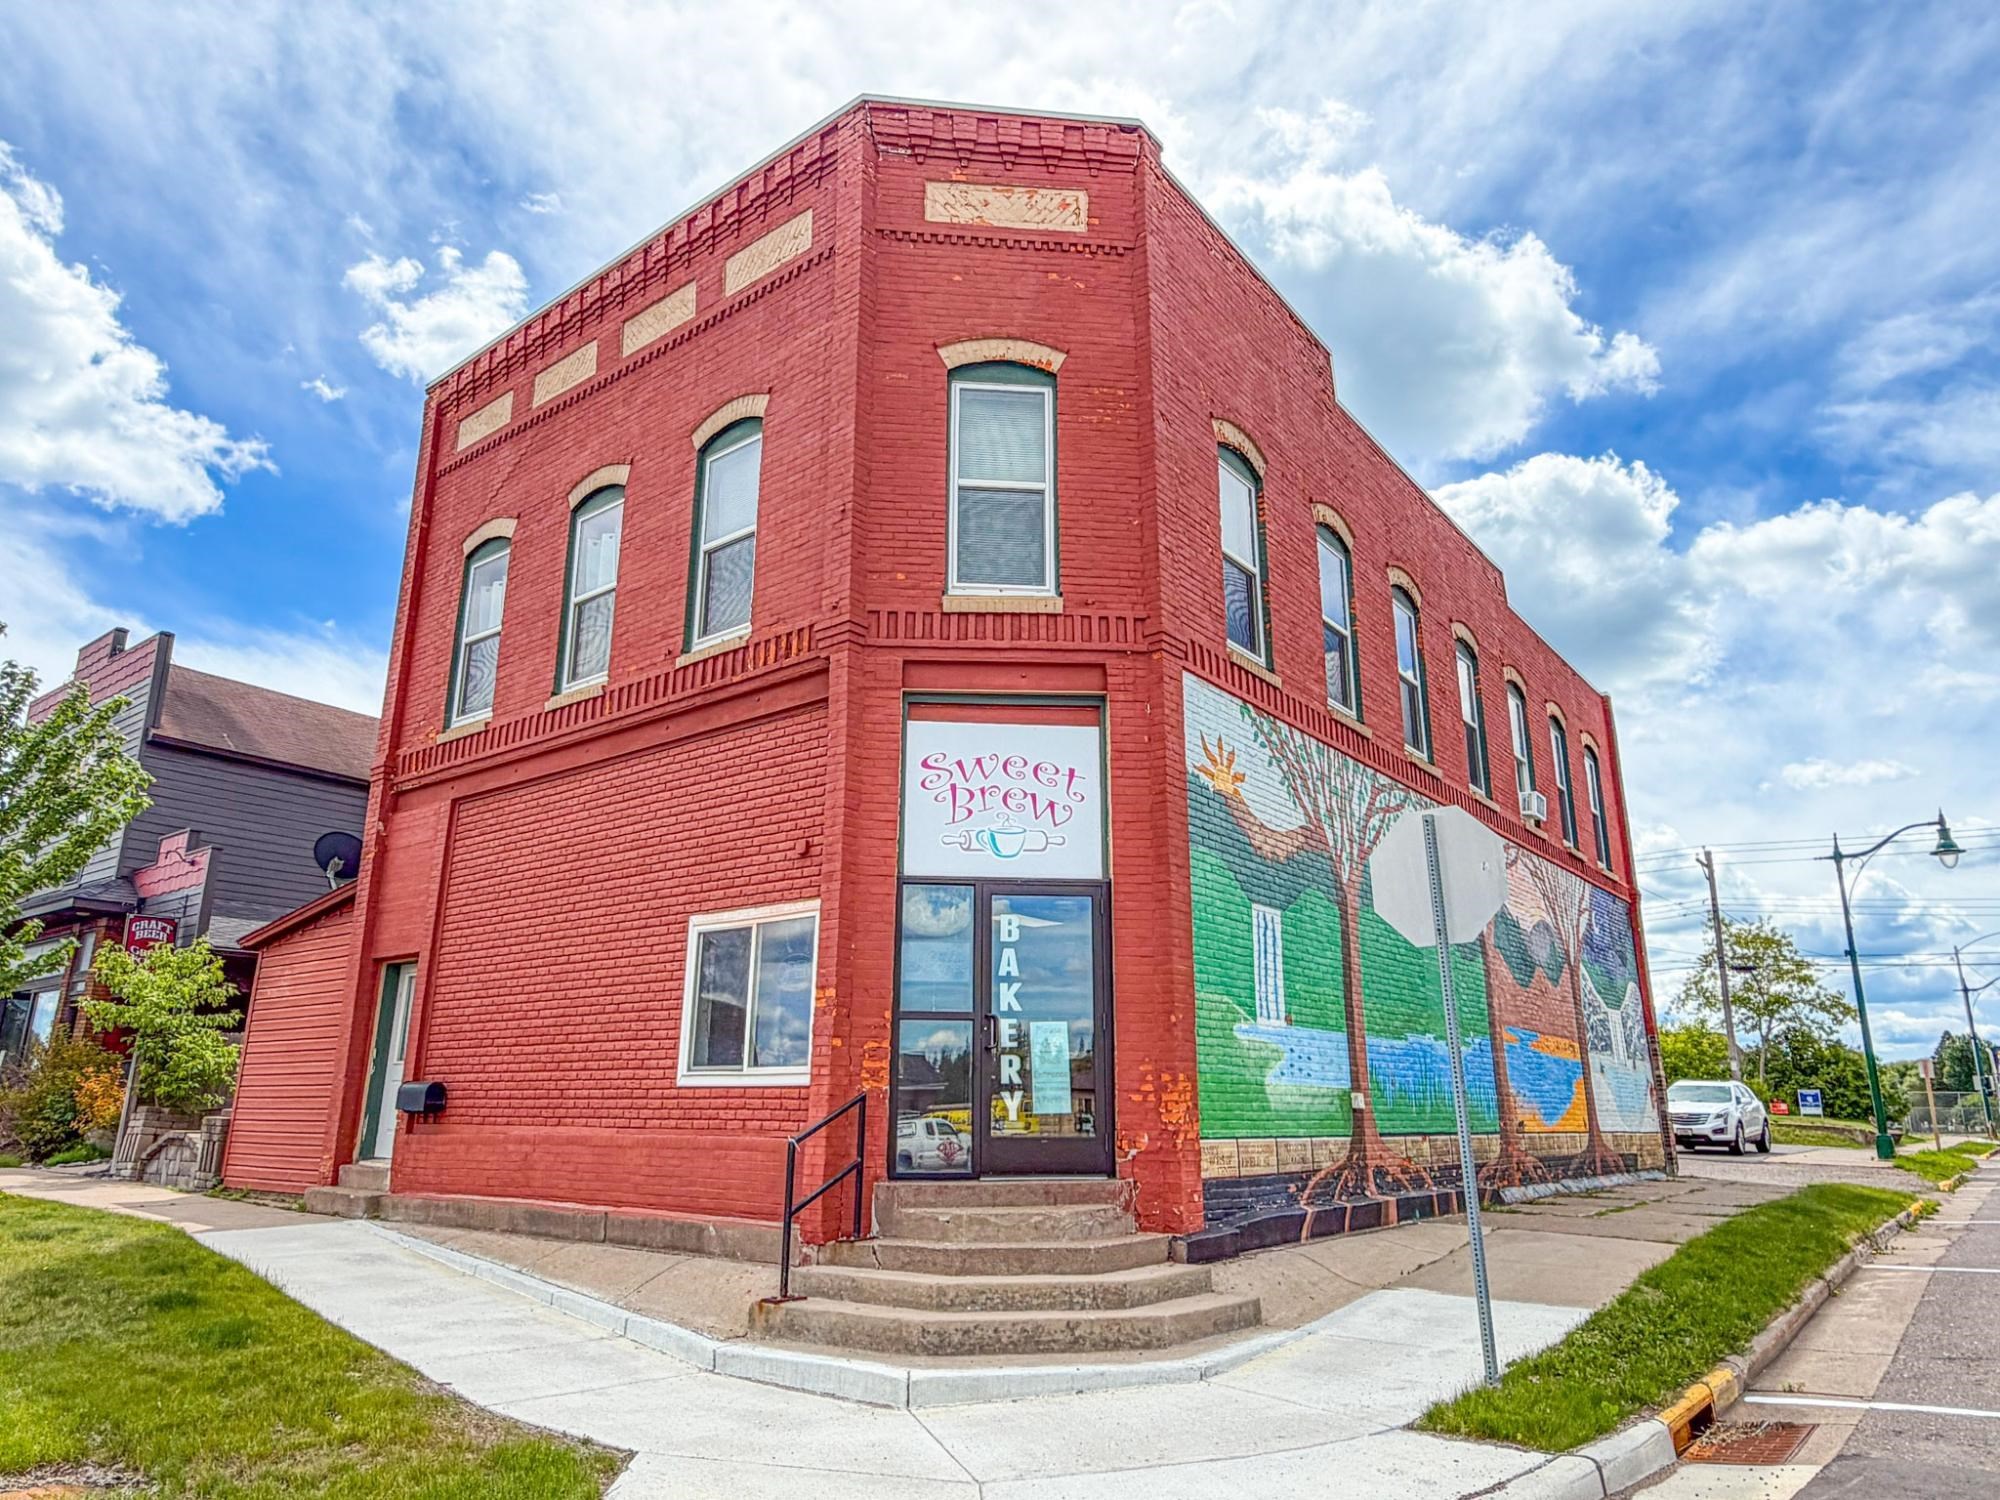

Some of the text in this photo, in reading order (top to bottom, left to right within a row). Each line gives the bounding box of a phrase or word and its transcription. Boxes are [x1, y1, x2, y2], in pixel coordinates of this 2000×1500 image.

[920, 752, 1086, 802] Sweet
[933, 783, 1073, 827] Brew
[132, 920, 173, 934] CRAFT
[135, 930, 167, 943] BEER
[998, 913, 1023, 1122] BAKERY
